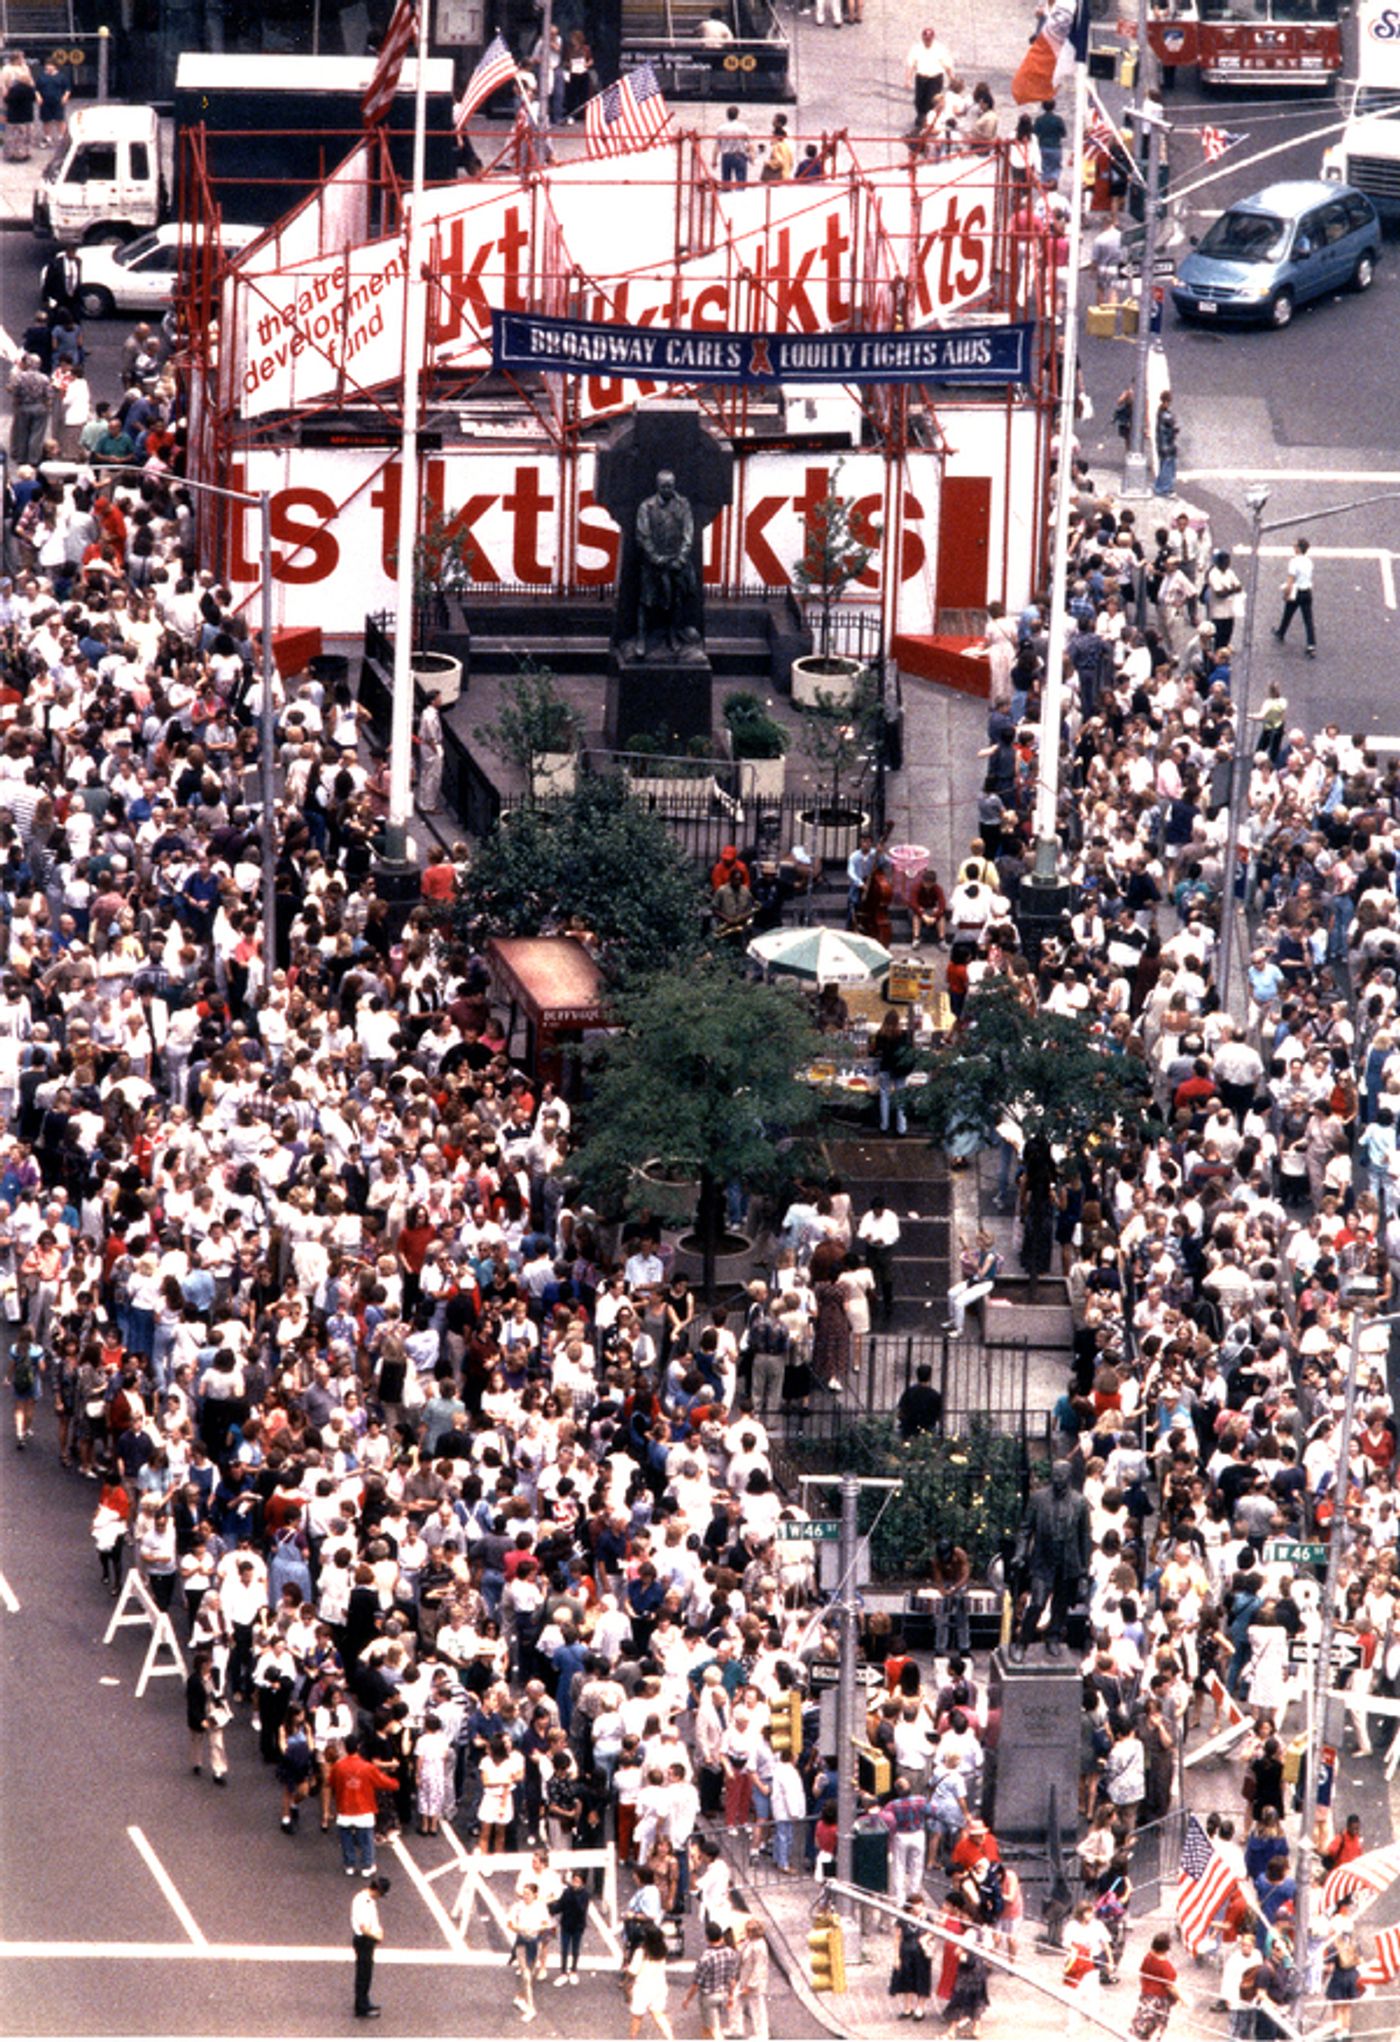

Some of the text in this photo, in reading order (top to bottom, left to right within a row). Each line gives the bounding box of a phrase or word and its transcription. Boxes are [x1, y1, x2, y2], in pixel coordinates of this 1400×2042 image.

[1374, 9, 1400, 38] S
[242, 246, 409, 394] development
[256, 265, 347, 347] theatre
[530, 328, 992, 368] BROADWAY CARES EQUITY FIGHTS AIDS
[804, 1523, 824, 1537] 46
[1291, 1546, 1311, 1561] 46
